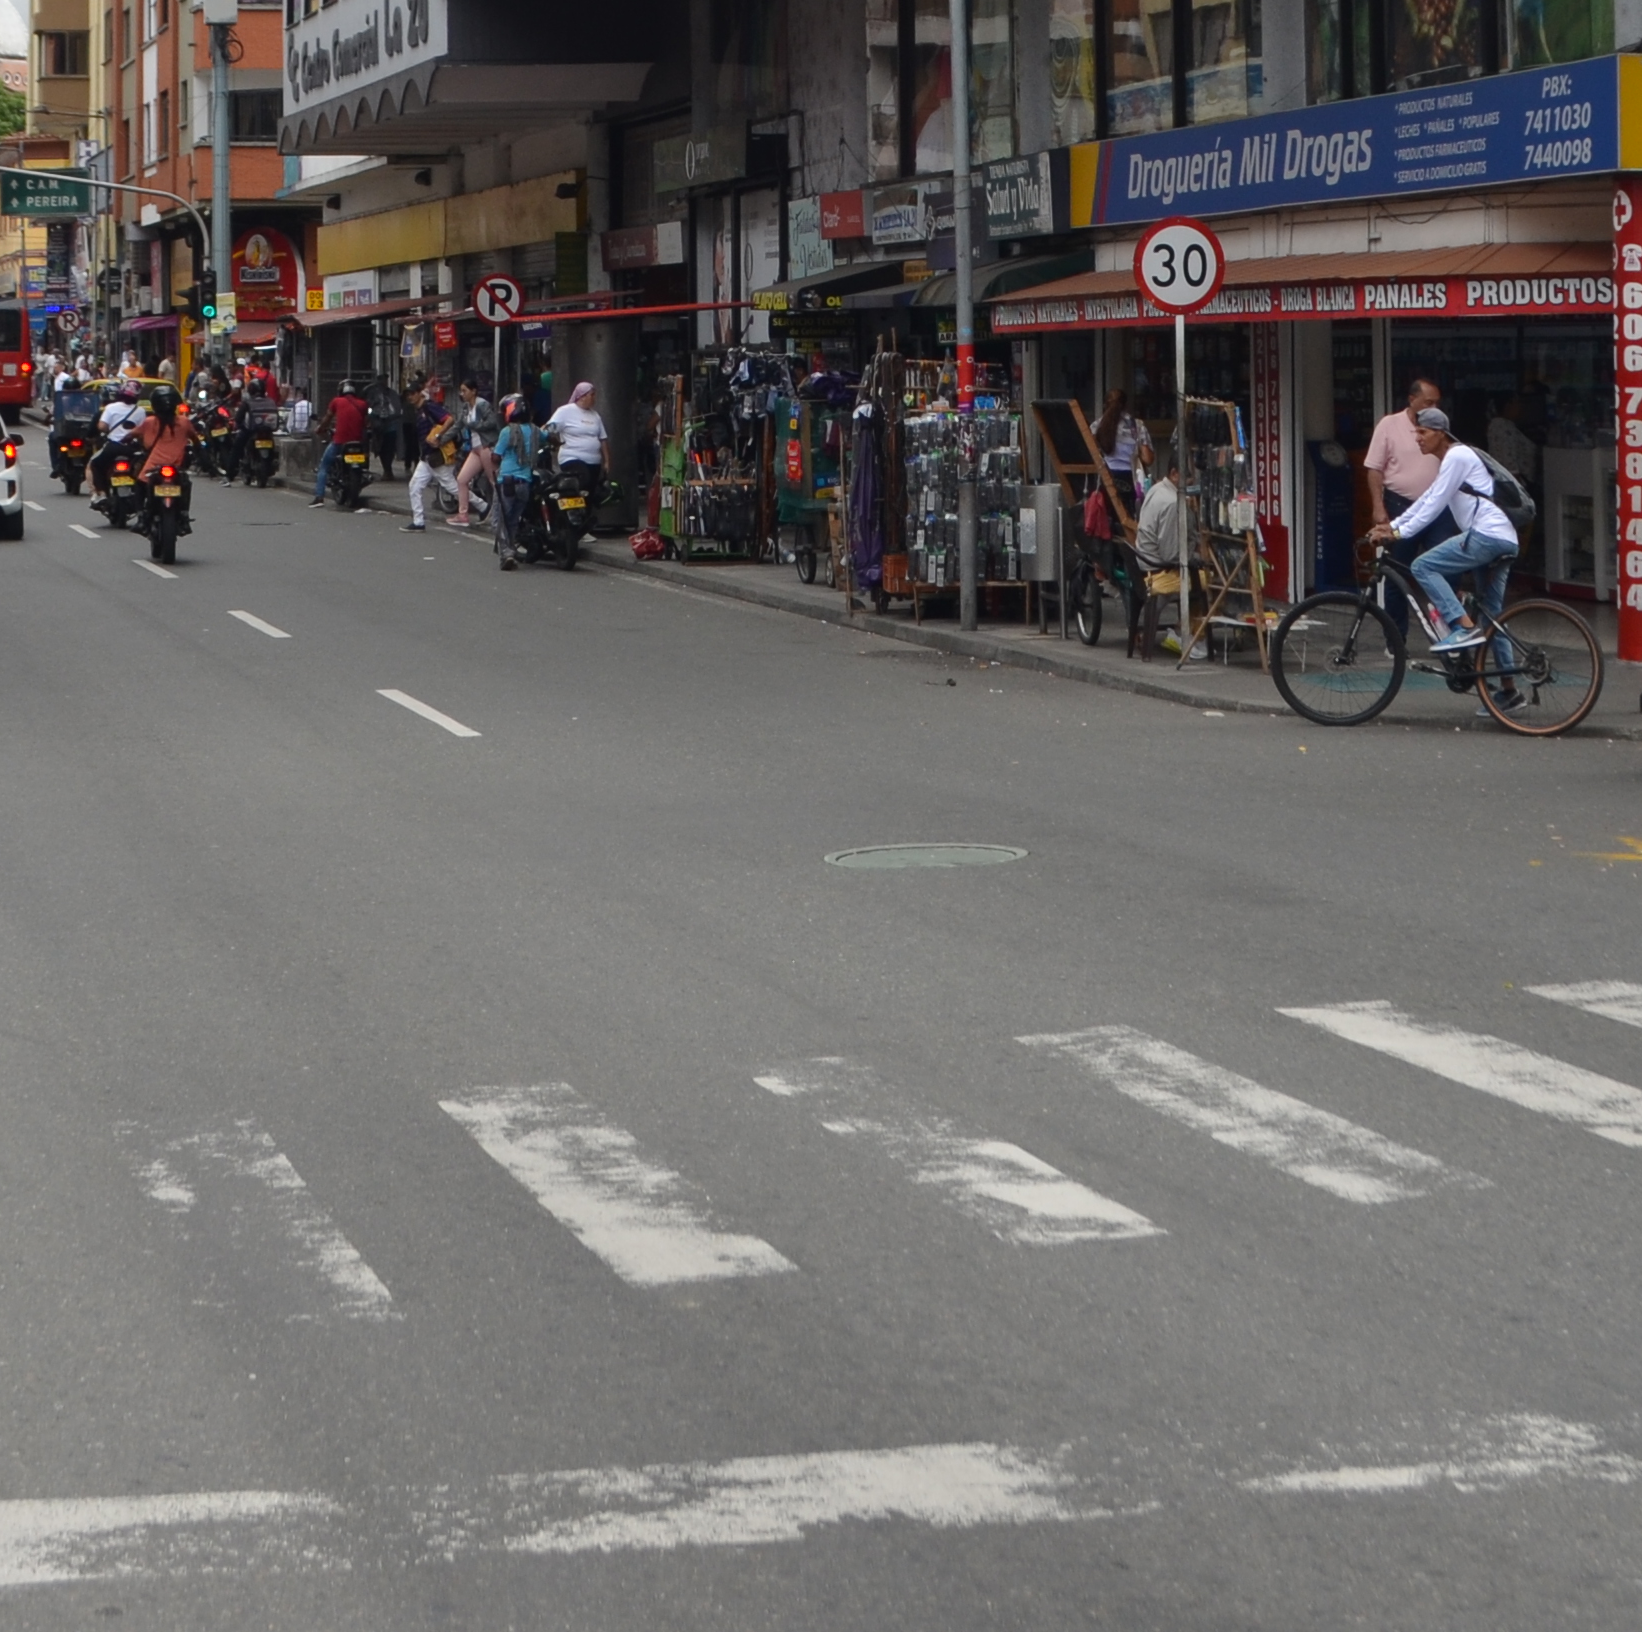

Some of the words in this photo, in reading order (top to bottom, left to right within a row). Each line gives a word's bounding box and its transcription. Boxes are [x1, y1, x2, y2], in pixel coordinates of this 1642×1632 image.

[1542, 74, 1572, 99] PBX:
[1524, 101, 1592, 136] 7411030
[1128, 137, 1233, 205] Droguería
[1239, 133, 1277, 186] Mil
[1283, 129, 1372, 186] Drogas
[1524, 137, 1592, 170] 7440098
[26, 196, 78, 207] PEREIRA
[986, 182, 1009, 216] Salud
[1011, 190, 1018, 221] y
[1017, 177, 1040, 211] Vida
[823, 208, 840, 228] Claro
[1151, 243, 1208, 289] 30
[1281, 287, 1313, 311] DROGA
[1316, 285, 1355, 311] BLANCA
[1466, 277, 1613, 308] PRODUCTOS
